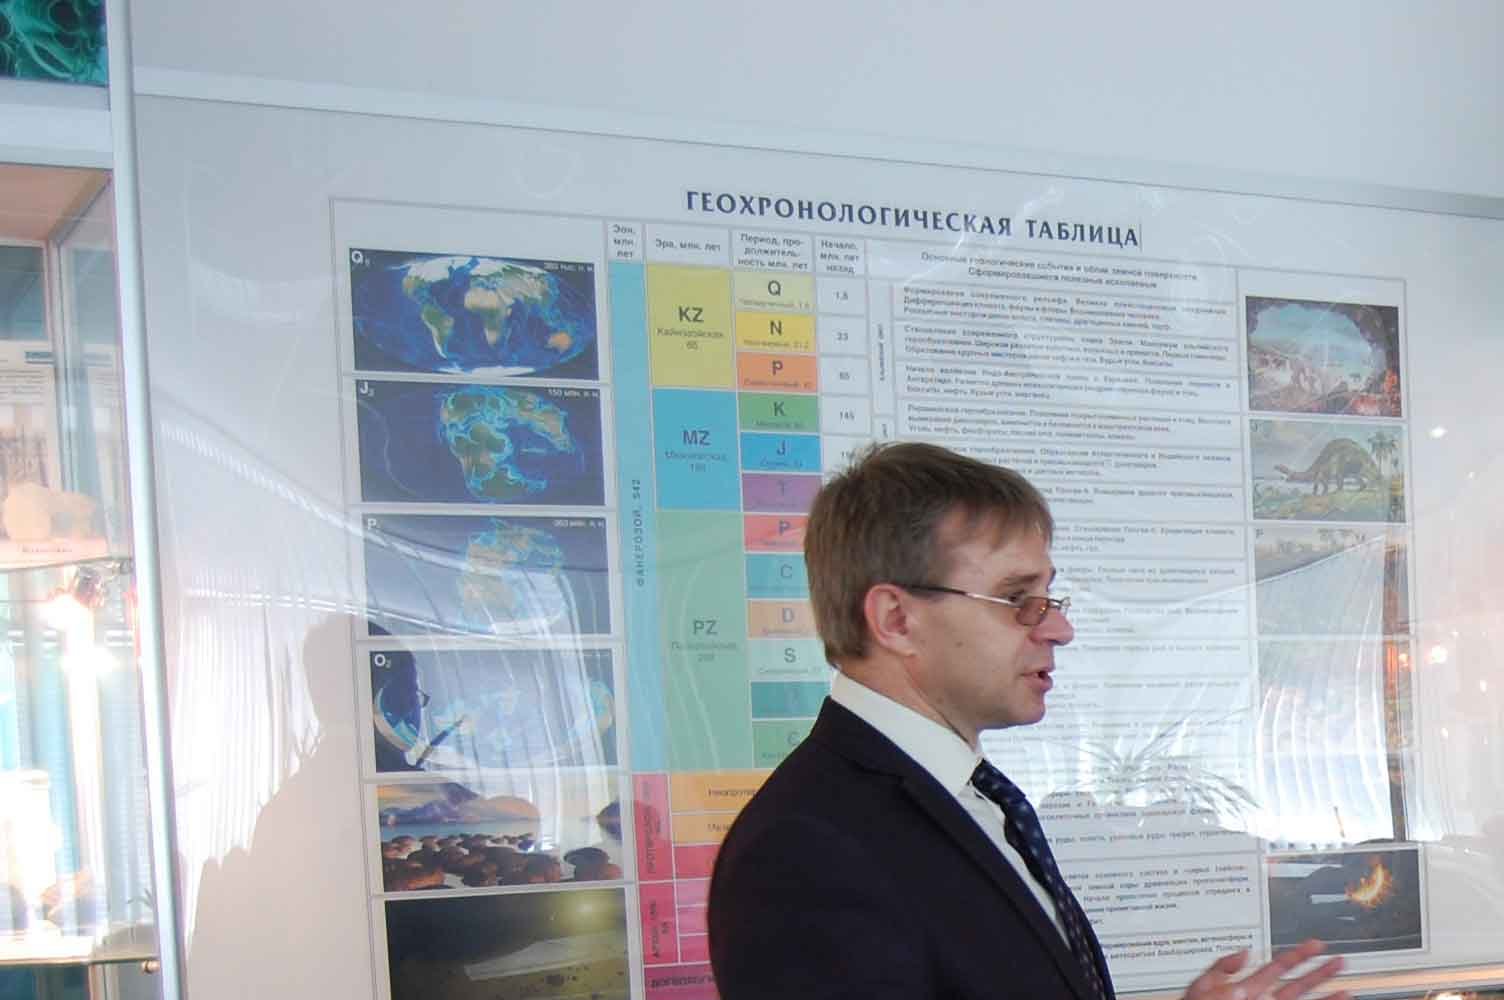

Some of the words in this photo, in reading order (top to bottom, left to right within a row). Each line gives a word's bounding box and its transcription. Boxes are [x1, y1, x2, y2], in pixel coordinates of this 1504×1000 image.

[686, 190, 1012, 238] ГЕОХРОНОЛОГИЧЕСКАЯ
[1025, 219, 1138, 248] ТАБЛИЦА
[767, 280, 782, 297] Q
[678, 306, 704, 324] KZ
[769, 319, 783, 336] N
[773, 400, 787, 417] K
[682, 429, 712, 447] MZ
[775, 440, 786, 456] J
[778, 519, 791, 537] P
[780, 563, 793, 580] C
[782, 607, 795, 623] D
[692, 618, 719, 636] PZ
[783, 647, 797, 664] S
